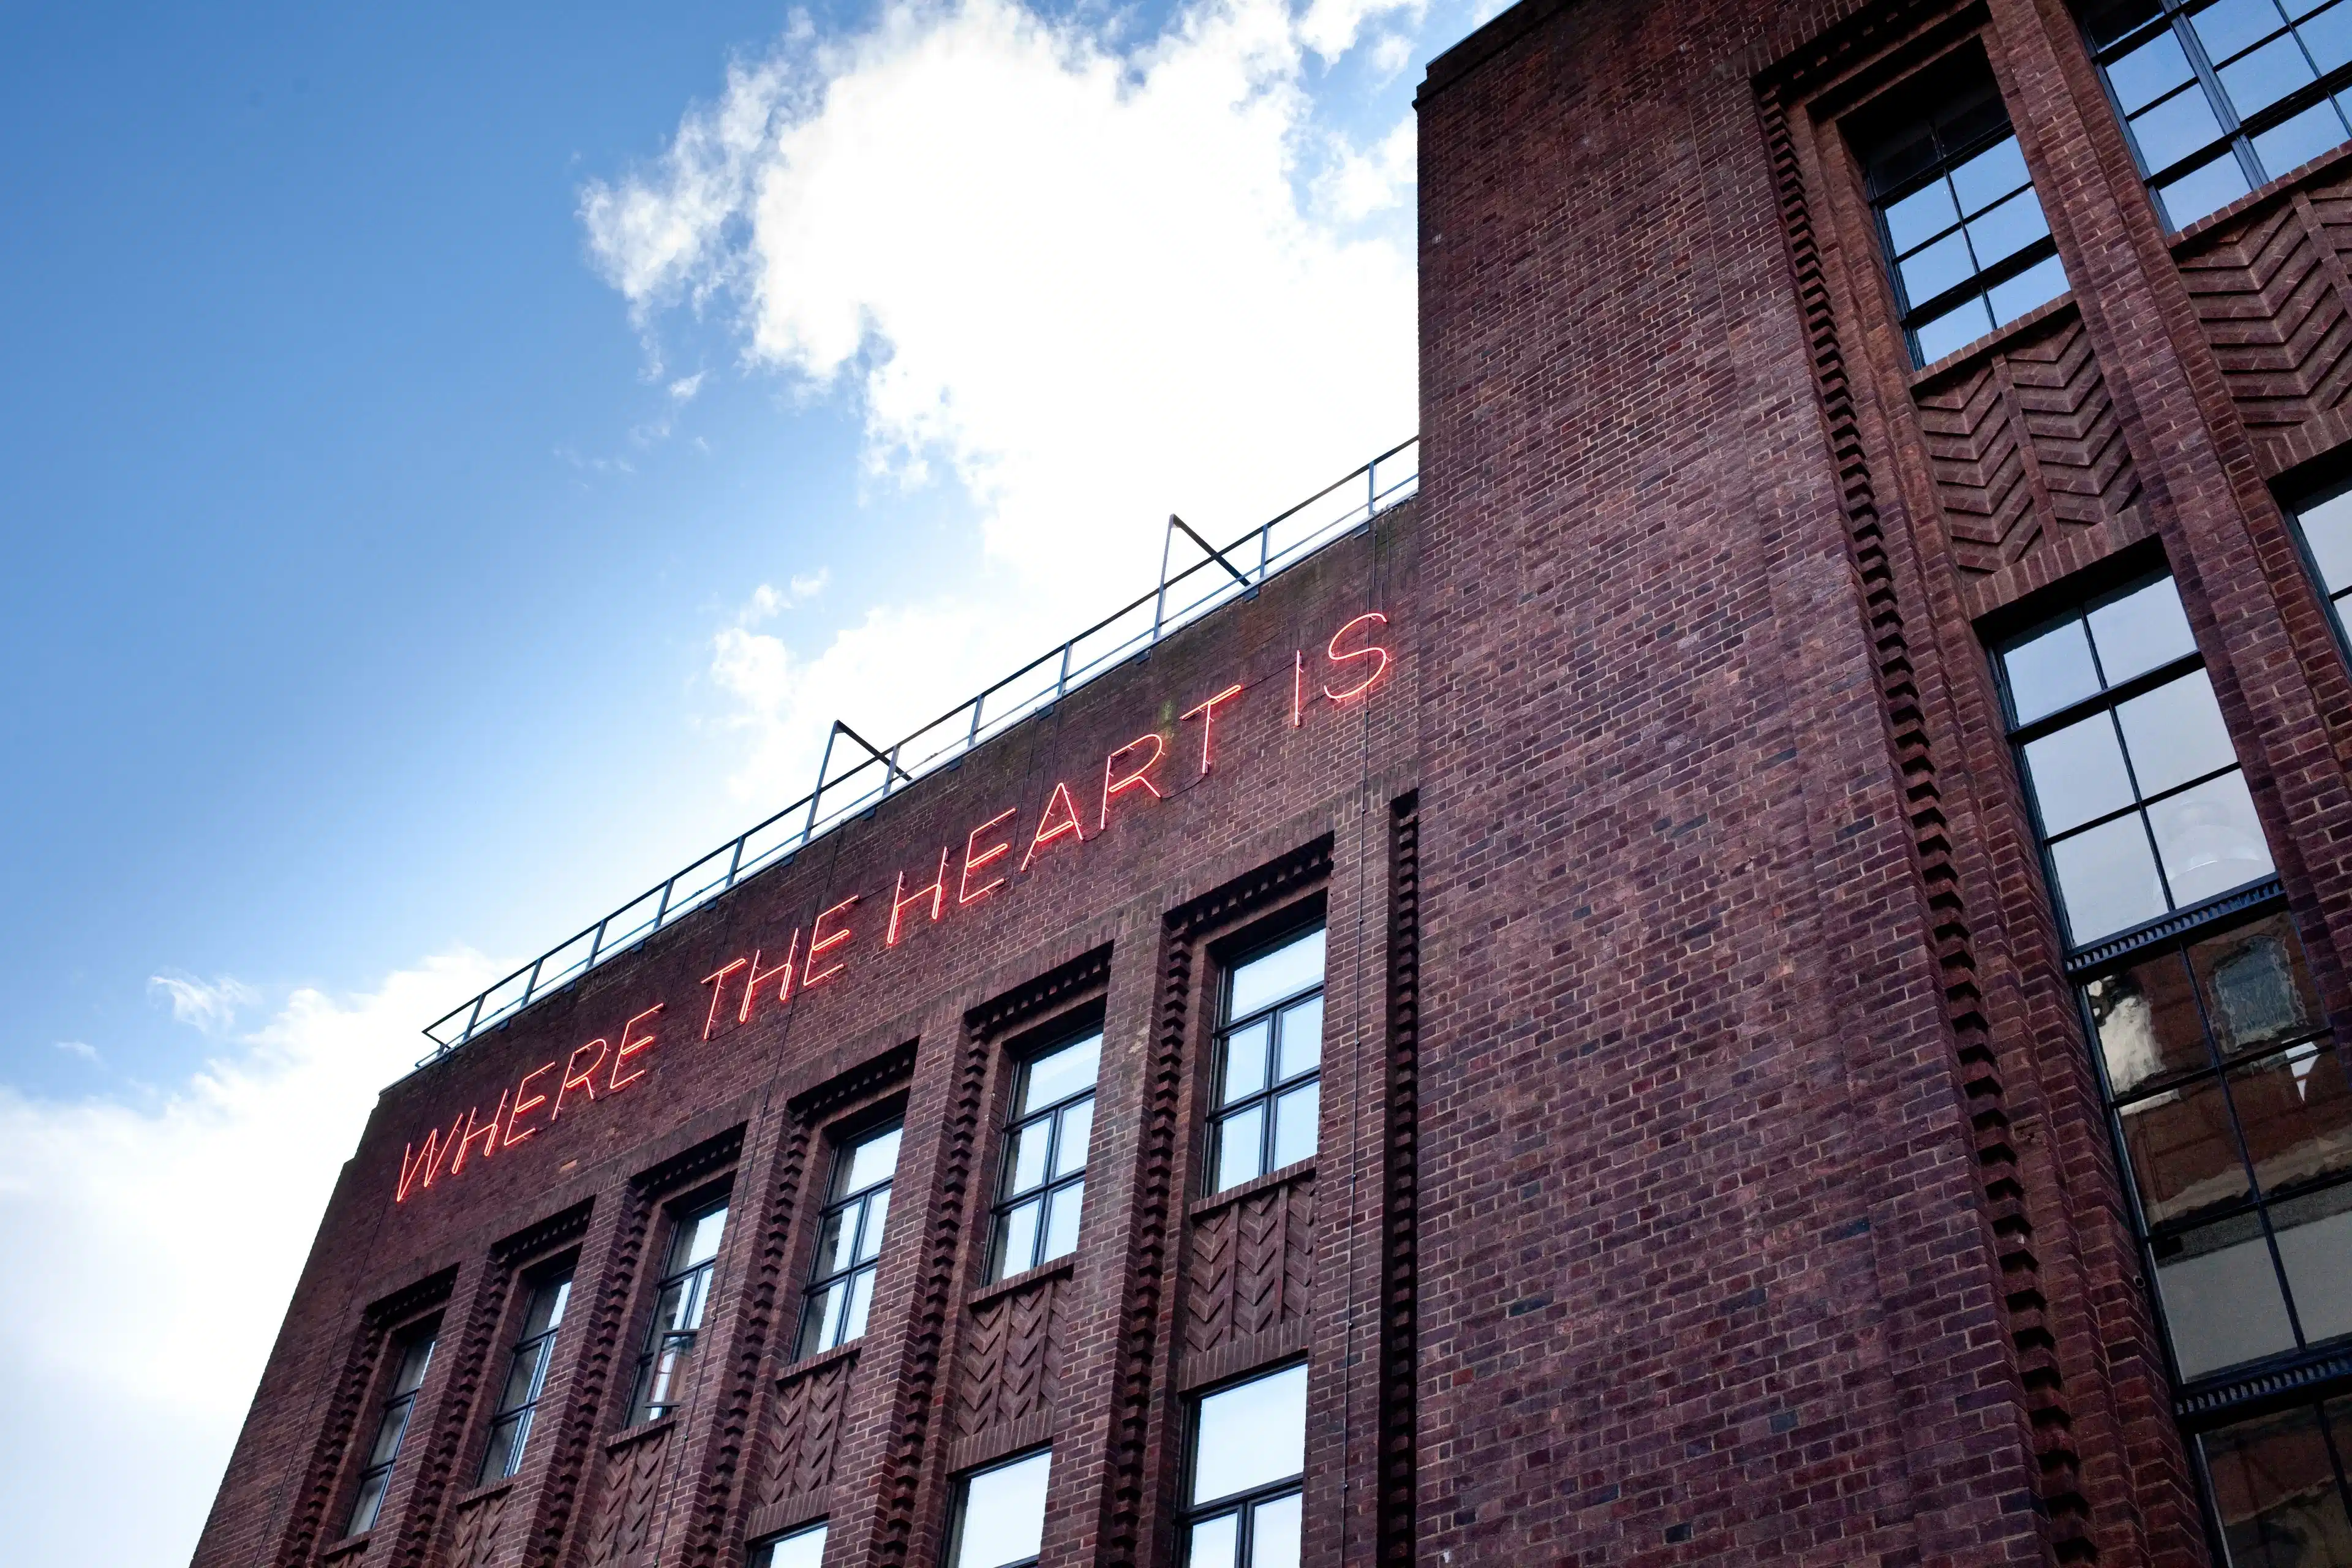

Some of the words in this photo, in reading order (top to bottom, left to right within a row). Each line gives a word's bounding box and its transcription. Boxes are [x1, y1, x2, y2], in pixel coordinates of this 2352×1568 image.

[395, 1002, 666, 1203] WHERE
[700, 894, 859, 1041] THE
[886, 684, 1243, 946] HEART
[1294, 612, 1393, 727] IS
